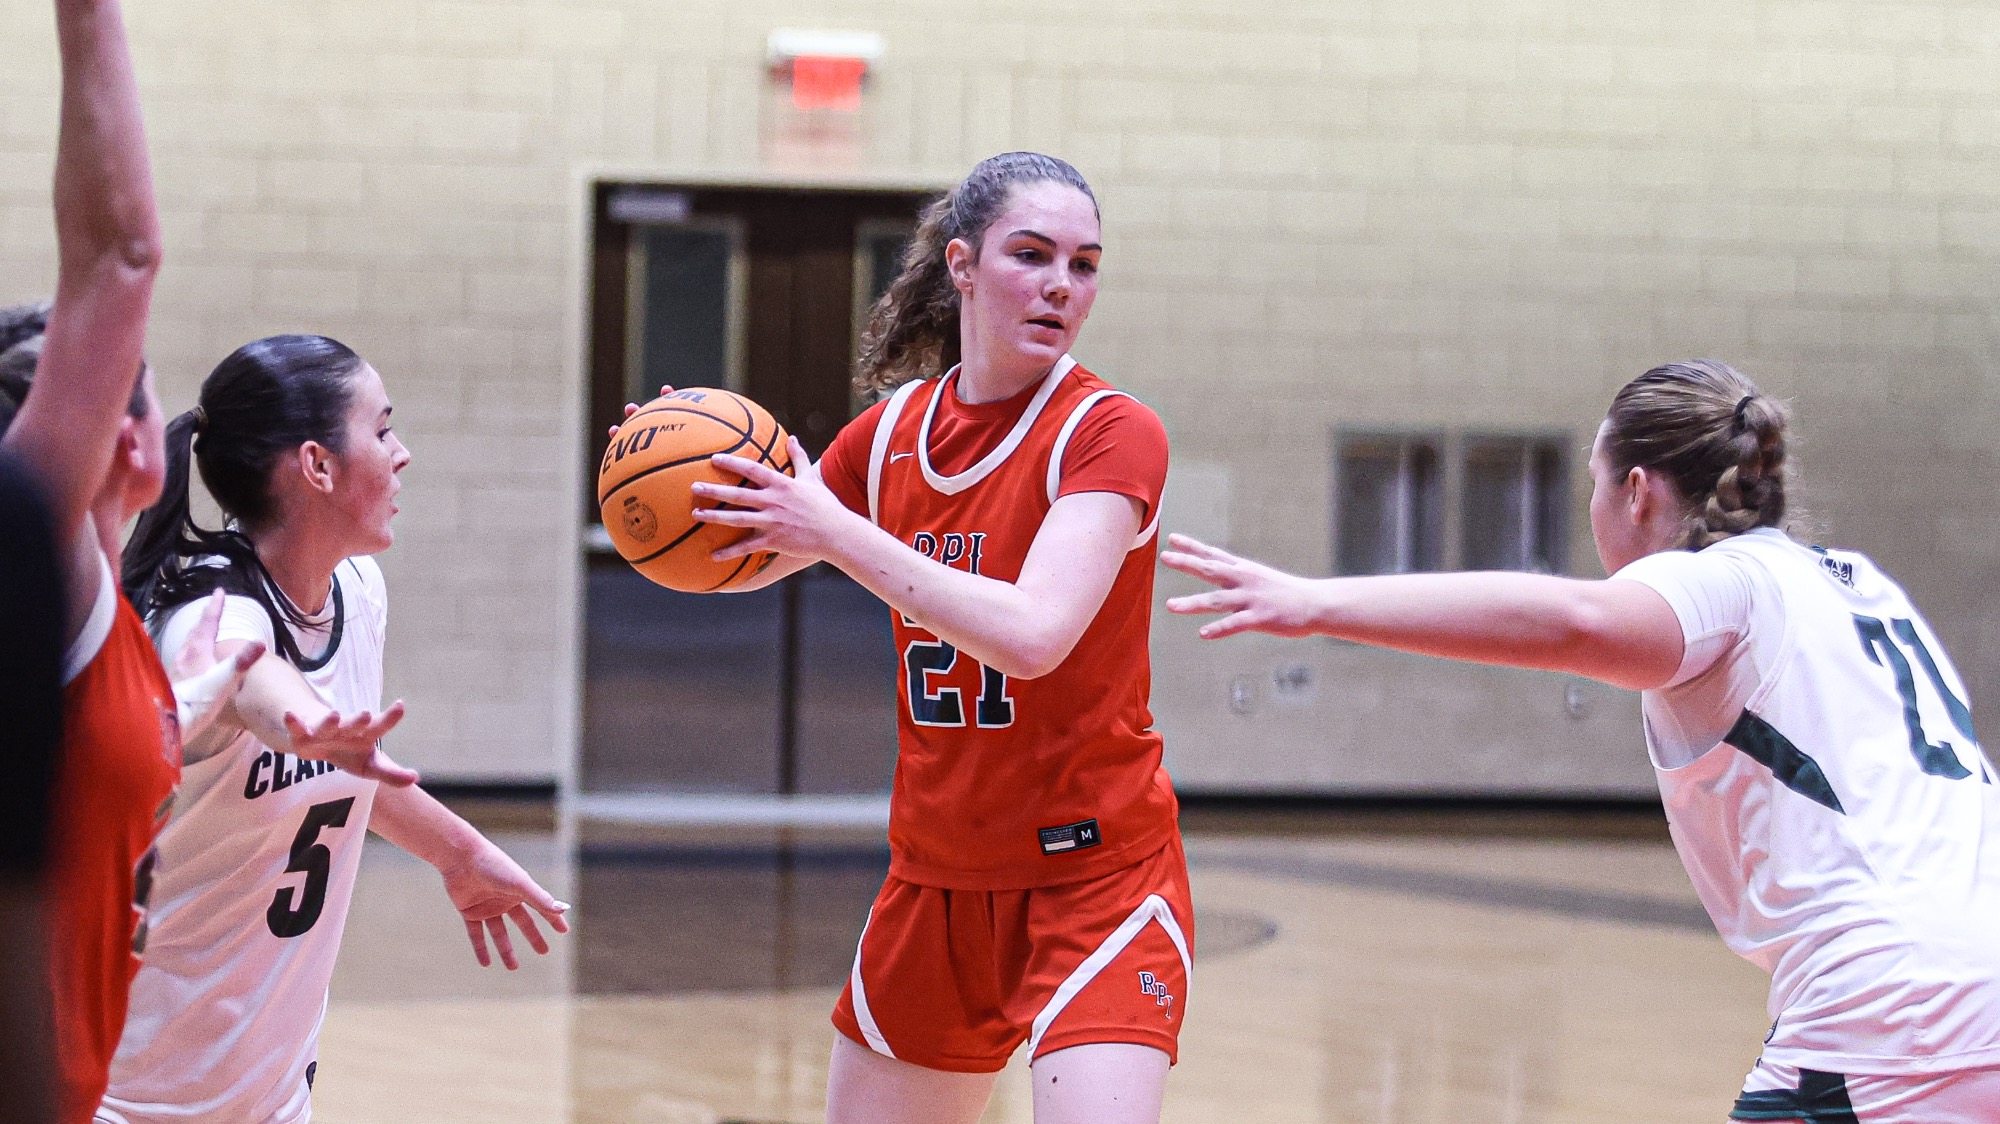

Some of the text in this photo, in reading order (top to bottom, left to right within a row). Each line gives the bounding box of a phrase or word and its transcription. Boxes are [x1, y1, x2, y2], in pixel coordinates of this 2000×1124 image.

[603, 426, 659, 475] EVO
[1080, 828, 1093, 841] M
[266, 796, 356, 938] 5
[1137, 971, 1174, 1020] RPI
